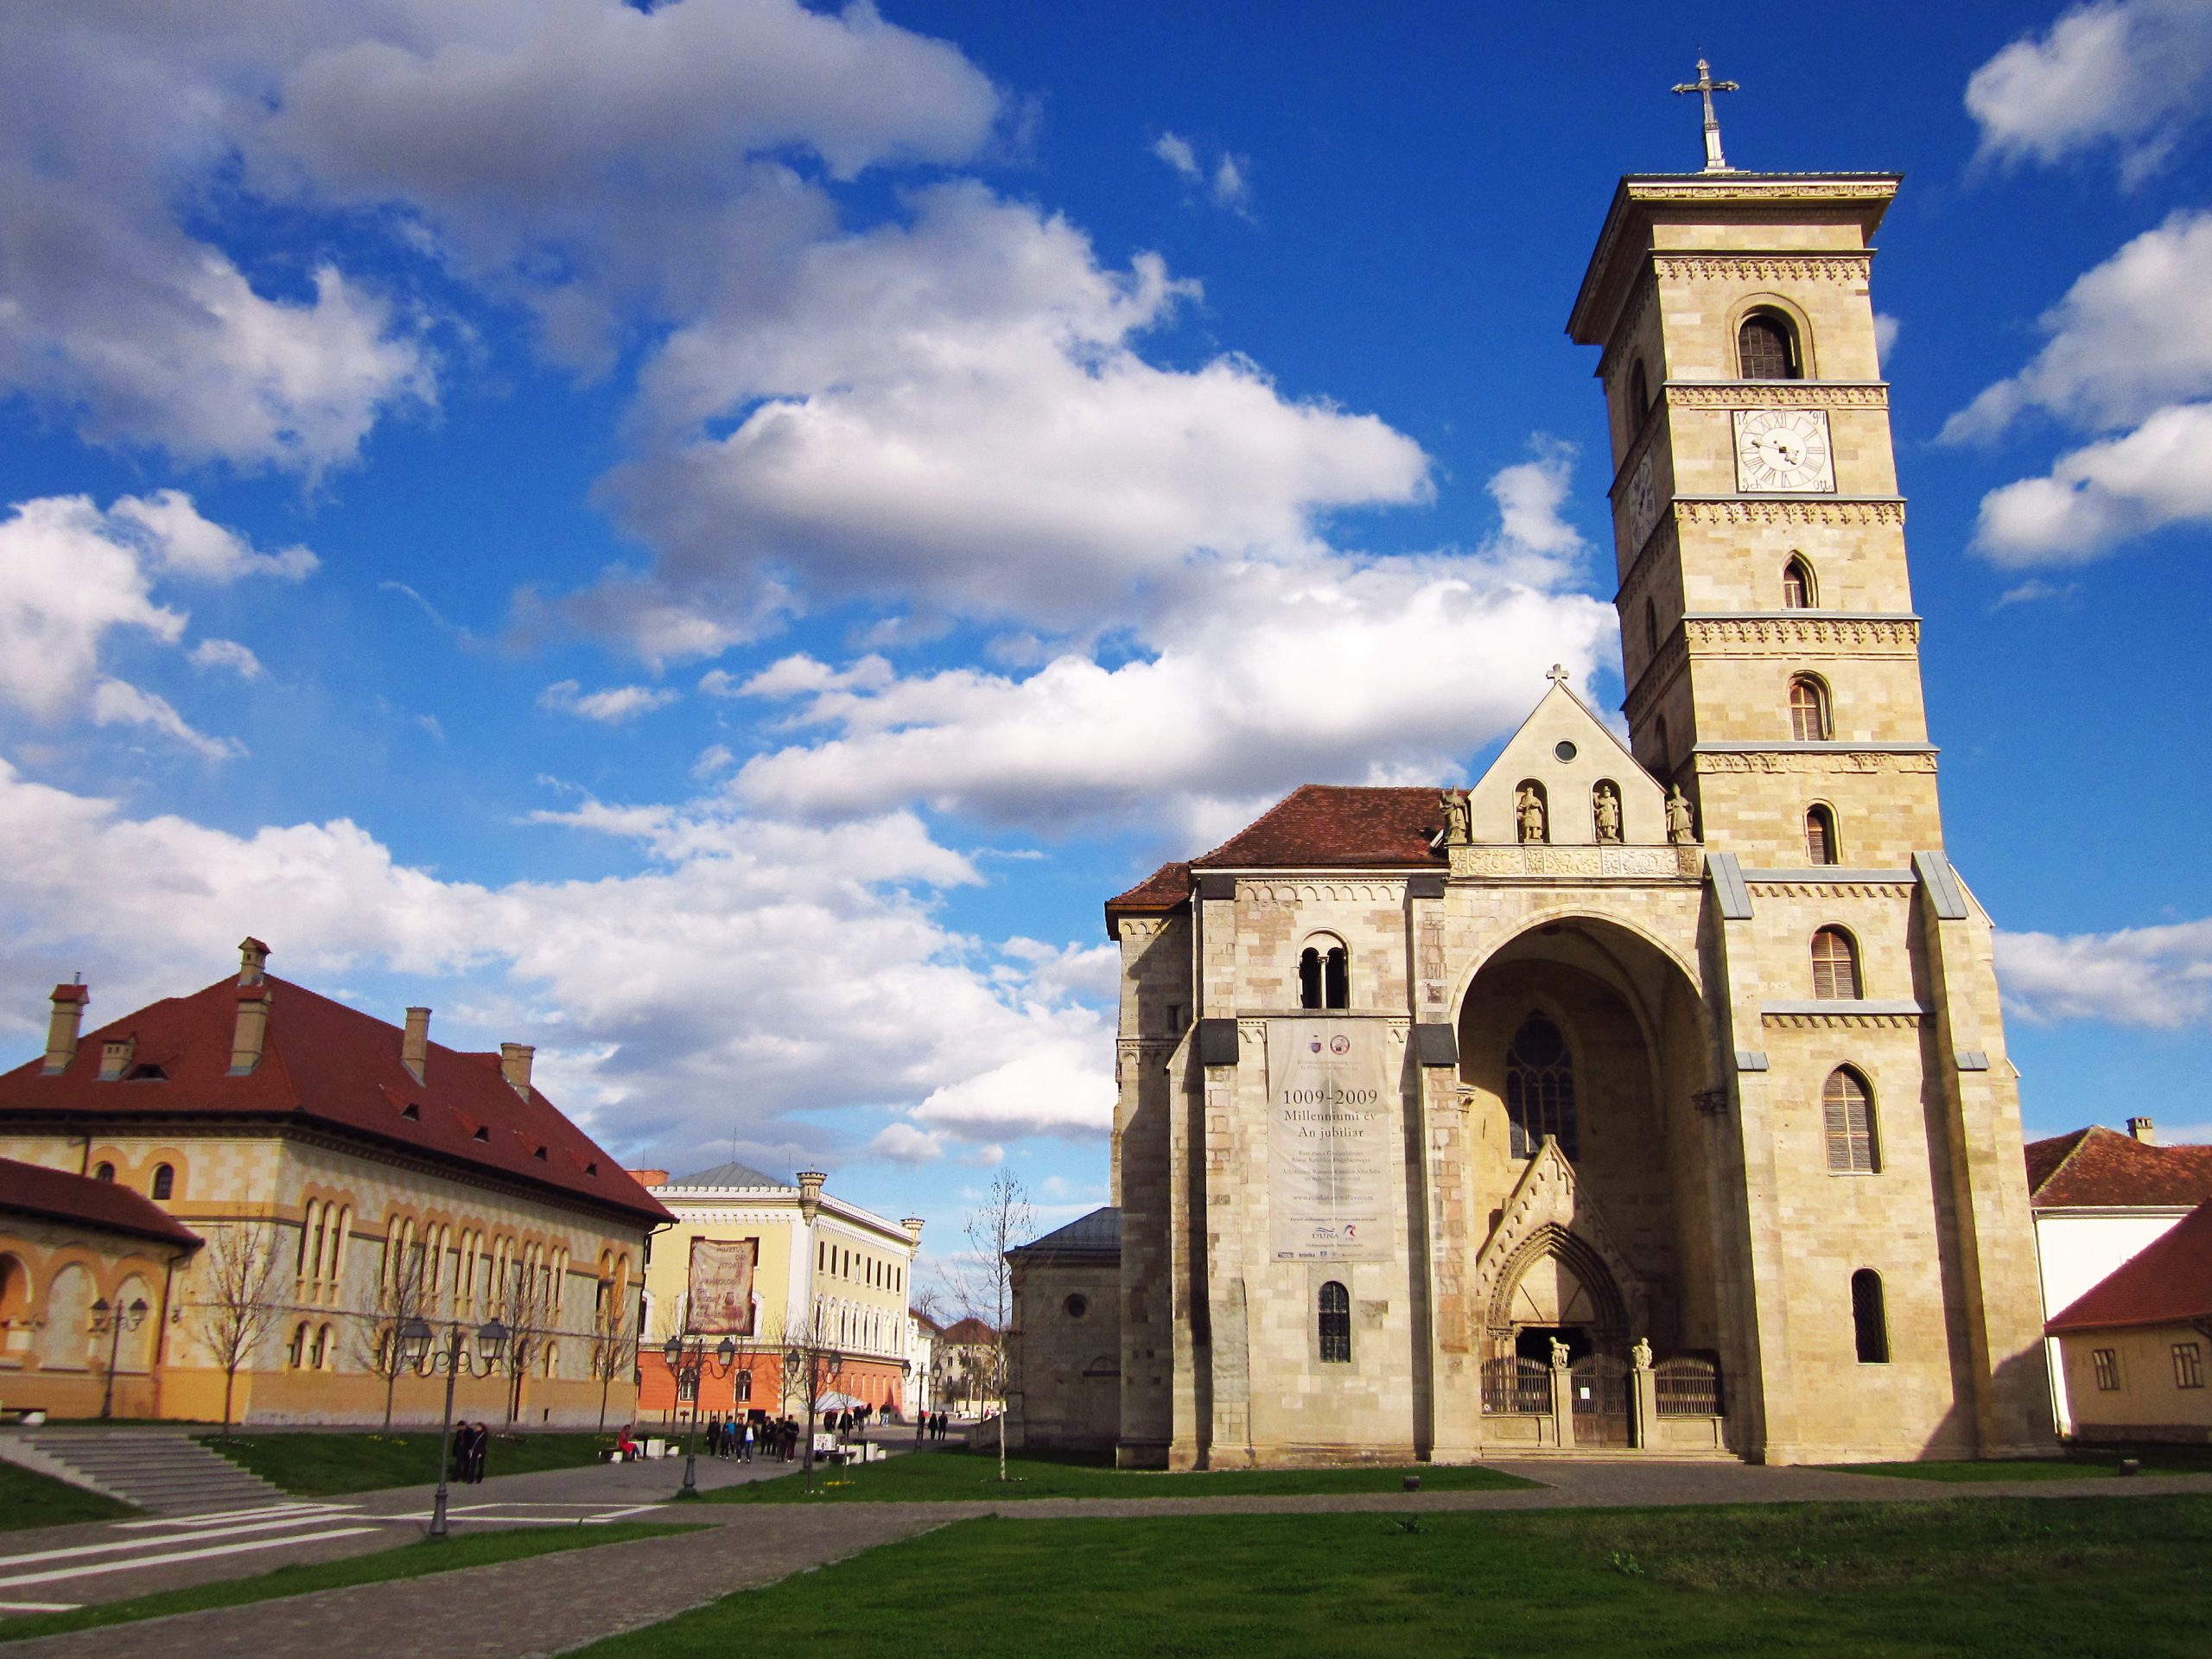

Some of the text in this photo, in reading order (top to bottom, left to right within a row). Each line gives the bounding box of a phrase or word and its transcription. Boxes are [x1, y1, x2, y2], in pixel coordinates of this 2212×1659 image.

[1283, 1090, 1377, 1104] 1009-2009
[1284, 1109, 1359, 1122] Millenniumi
[1299, 1126, 1363, 1141] An jubiliar
